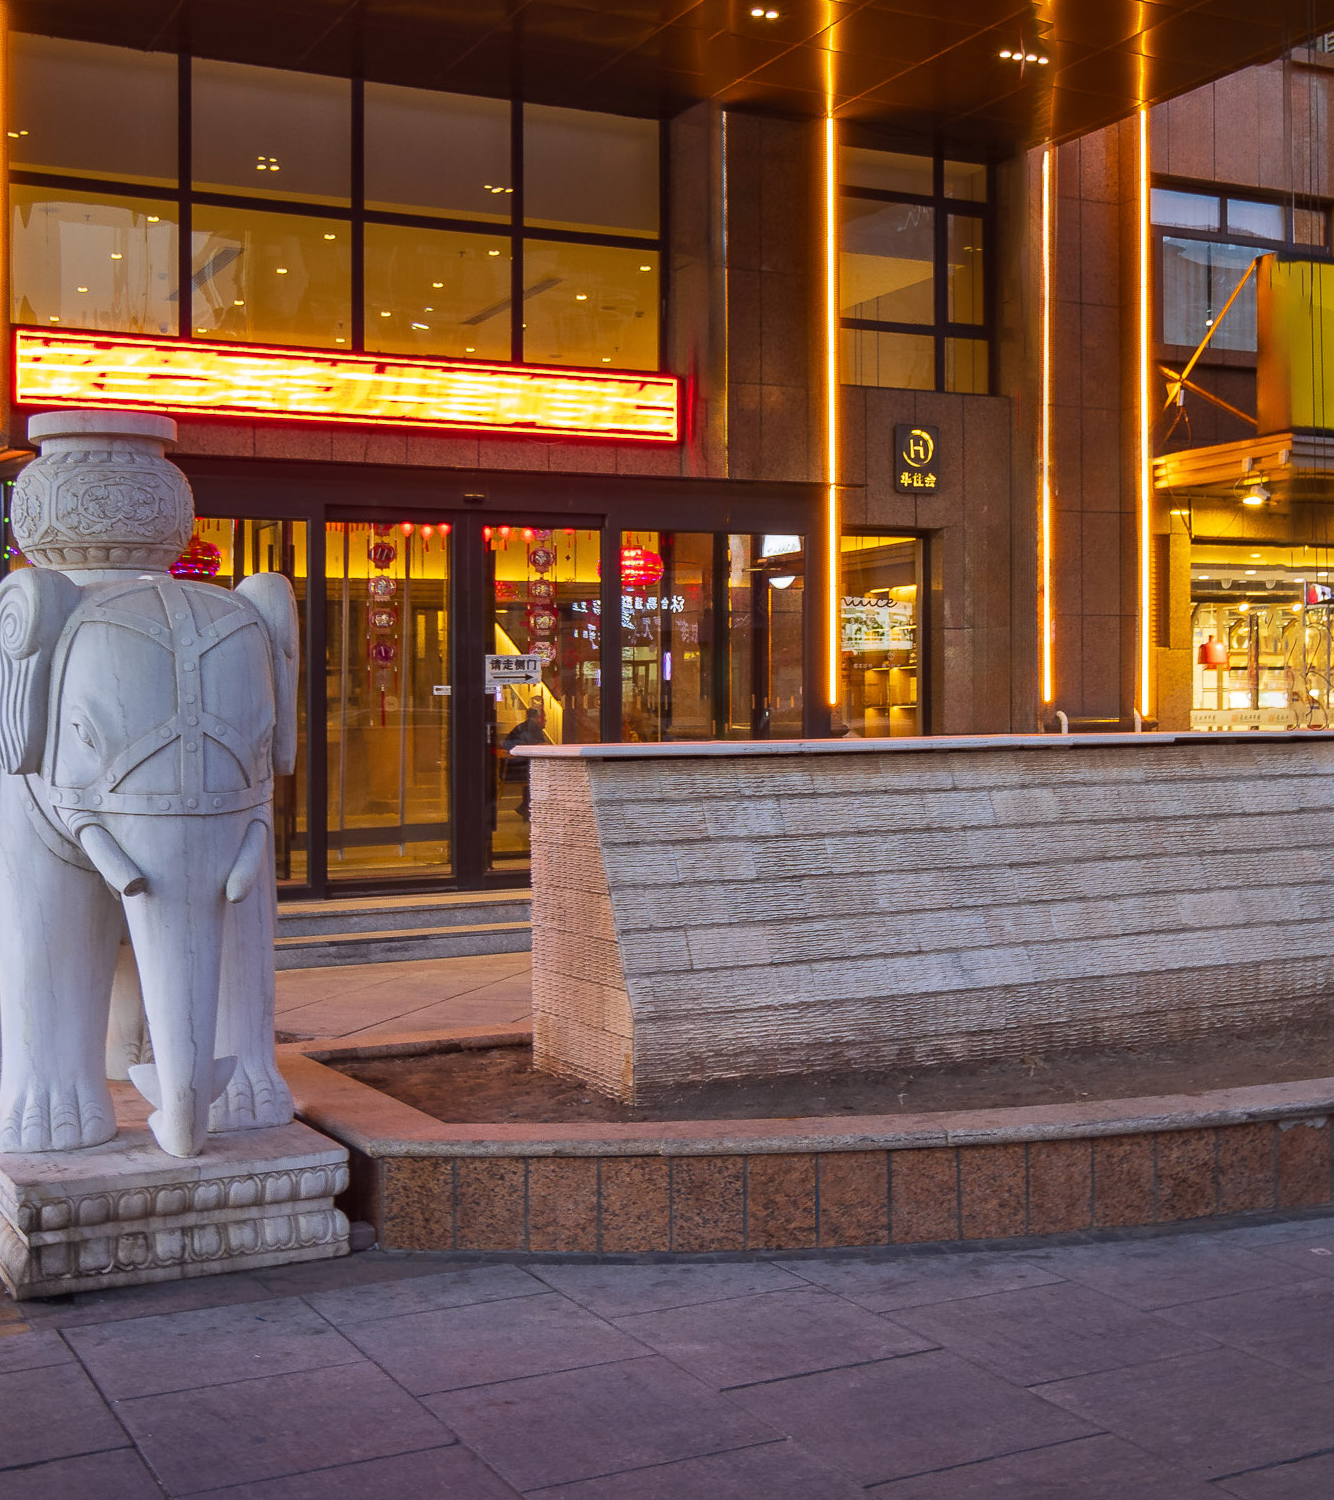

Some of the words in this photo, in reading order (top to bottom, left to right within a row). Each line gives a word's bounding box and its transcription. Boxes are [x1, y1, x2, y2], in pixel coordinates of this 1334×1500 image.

[900, 471, 937, 488] 华住会
[490, 658, 537, 671] 请走侧门
